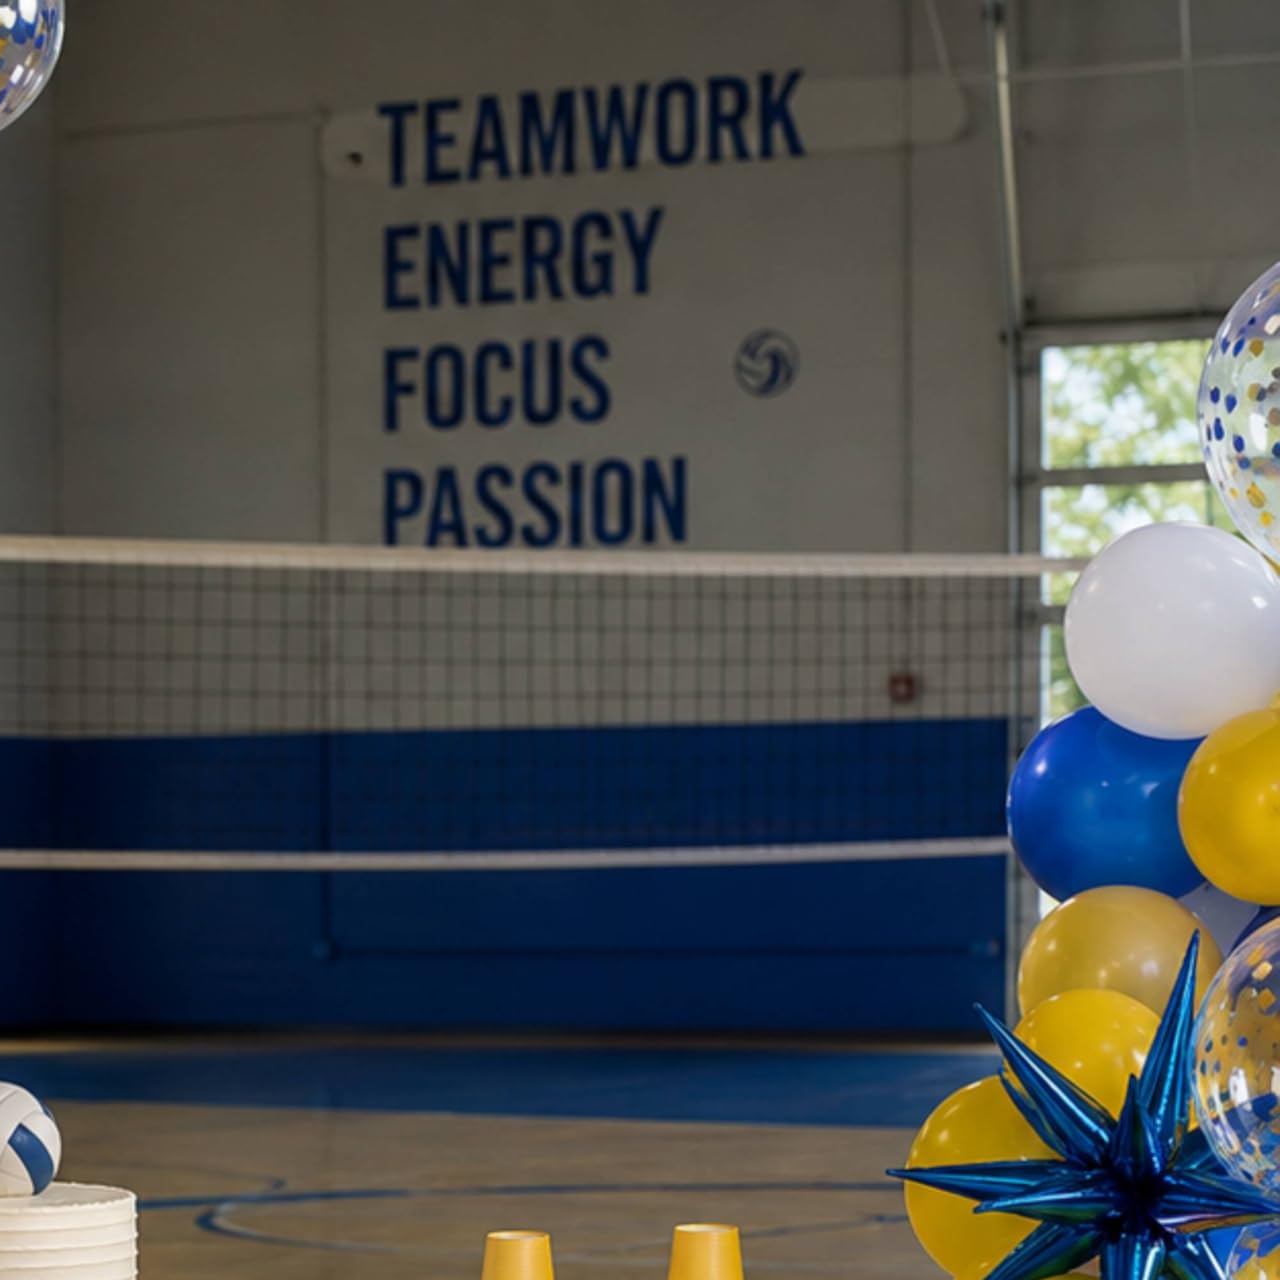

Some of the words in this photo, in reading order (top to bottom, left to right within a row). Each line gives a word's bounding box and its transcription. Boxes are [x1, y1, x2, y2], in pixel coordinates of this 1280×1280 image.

[377, 69, 806, 188] TEAMWORK
[383, 206, 664, 311] ENERGY
[384, 335, 611, 433] FOCUS
[383, 456, 687, 548] PASSION
